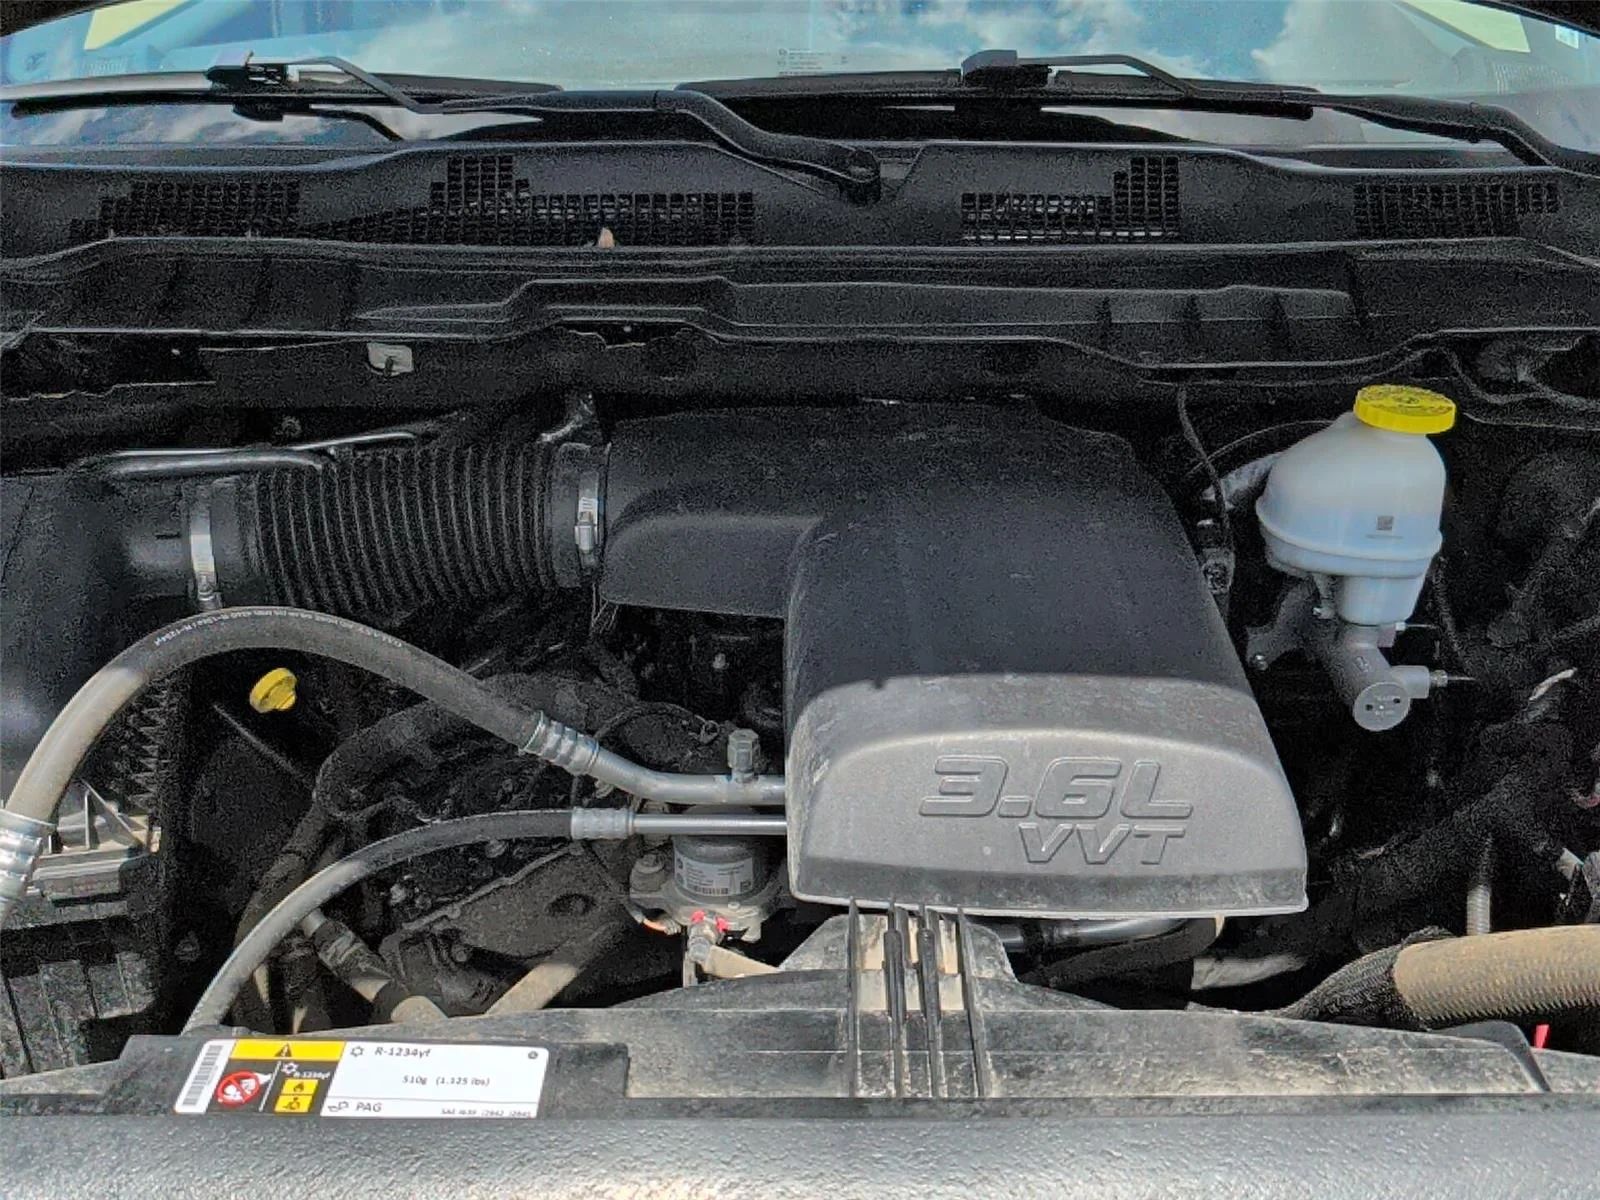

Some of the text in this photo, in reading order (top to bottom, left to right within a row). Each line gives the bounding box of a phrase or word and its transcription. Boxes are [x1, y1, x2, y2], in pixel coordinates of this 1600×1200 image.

[919, 755, 1193, 819] 3.6L
[1018, 822, 1186, 865] VVT
[374, 1046, 432, 1059] R-1234yf
[402, 1074, 428, 1086] 510g
[356, 1101, 382, 1113] PAG
